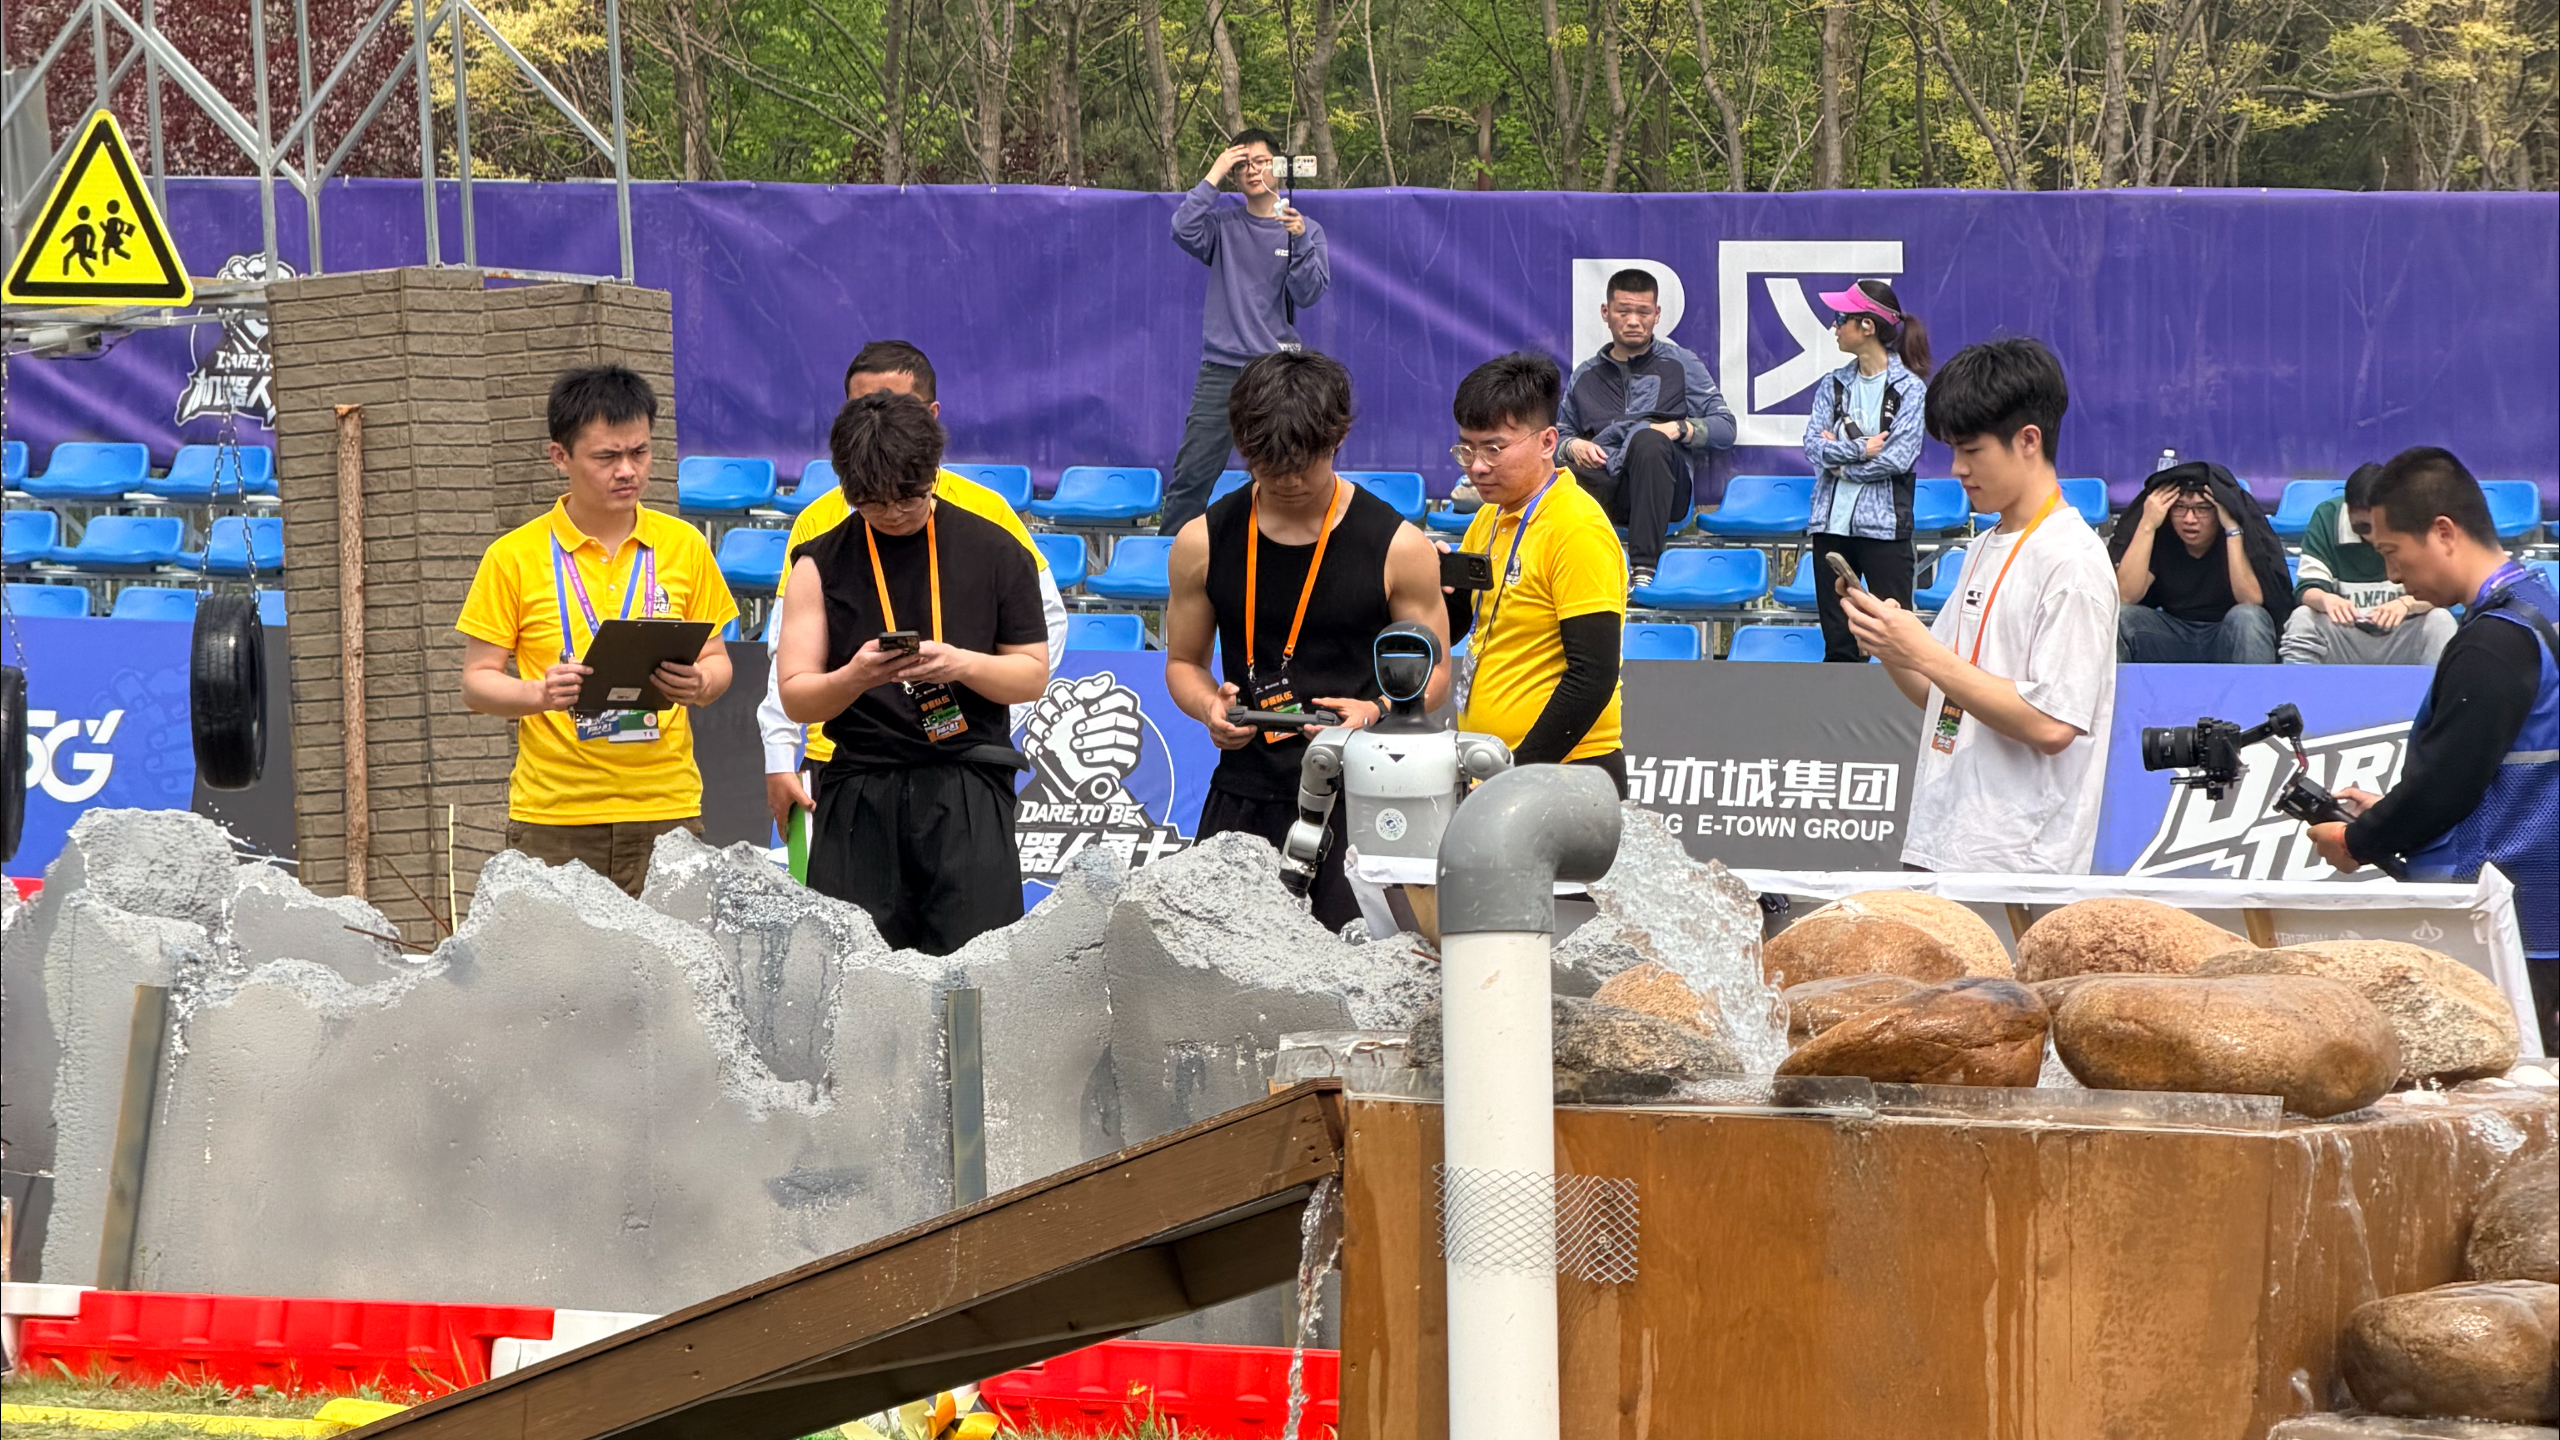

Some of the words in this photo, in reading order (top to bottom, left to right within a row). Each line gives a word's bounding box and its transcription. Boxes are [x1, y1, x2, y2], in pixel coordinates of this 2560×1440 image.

[1697, 814, 1796, 838] E-TOWN
[1803, 818, 1895, 842] GROUP
[1015, 829, 1183, 874] 器人勇士
